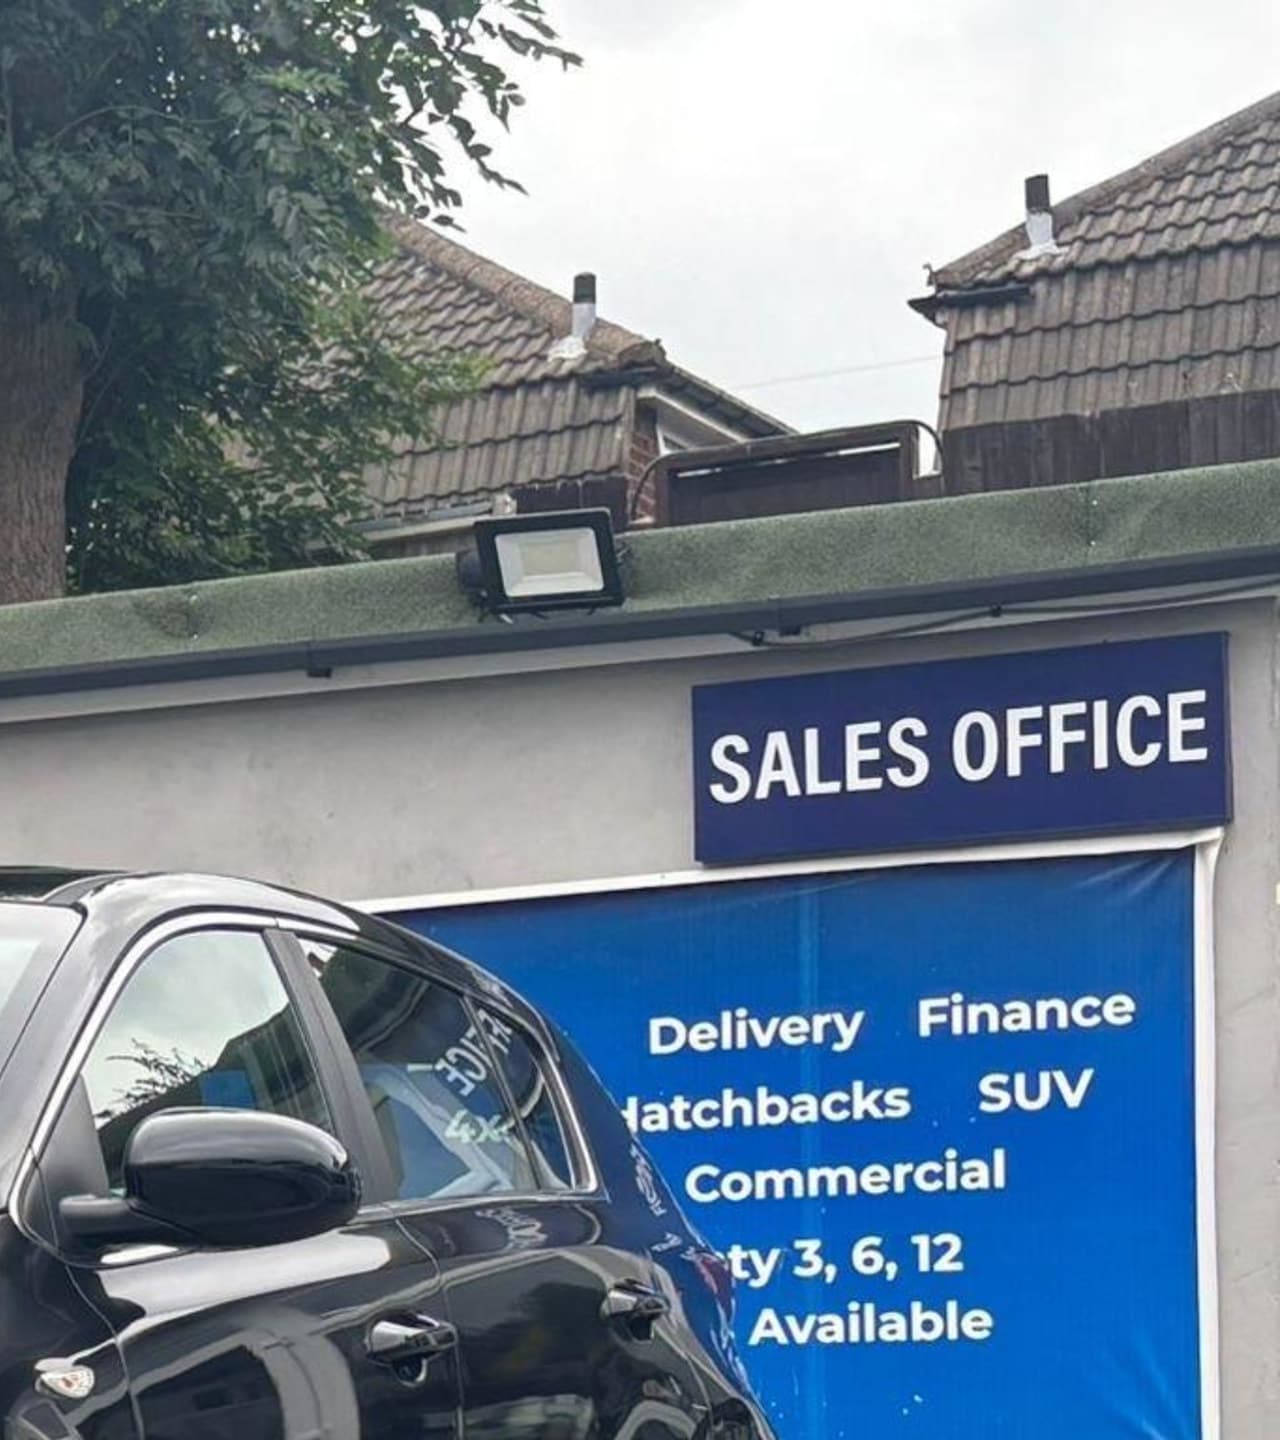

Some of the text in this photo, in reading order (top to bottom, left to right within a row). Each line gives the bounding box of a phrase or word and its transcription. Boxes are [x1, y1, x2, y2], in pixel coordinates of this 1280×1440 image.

[710, 690, 1208, 804] SALES OFFICE
[649, 992, 1136, 1054] Delivery Finance
[979, 1069, 1094, 1112] SUV
[685, 1149, 1005, 1202] Commercial
[794, 1239, 837, 1283] 3,
[852, 1236, 897, 1281] 6,
[911, 1233, 963, 1272] 12
[748, 1300, 993, 1346] Available
